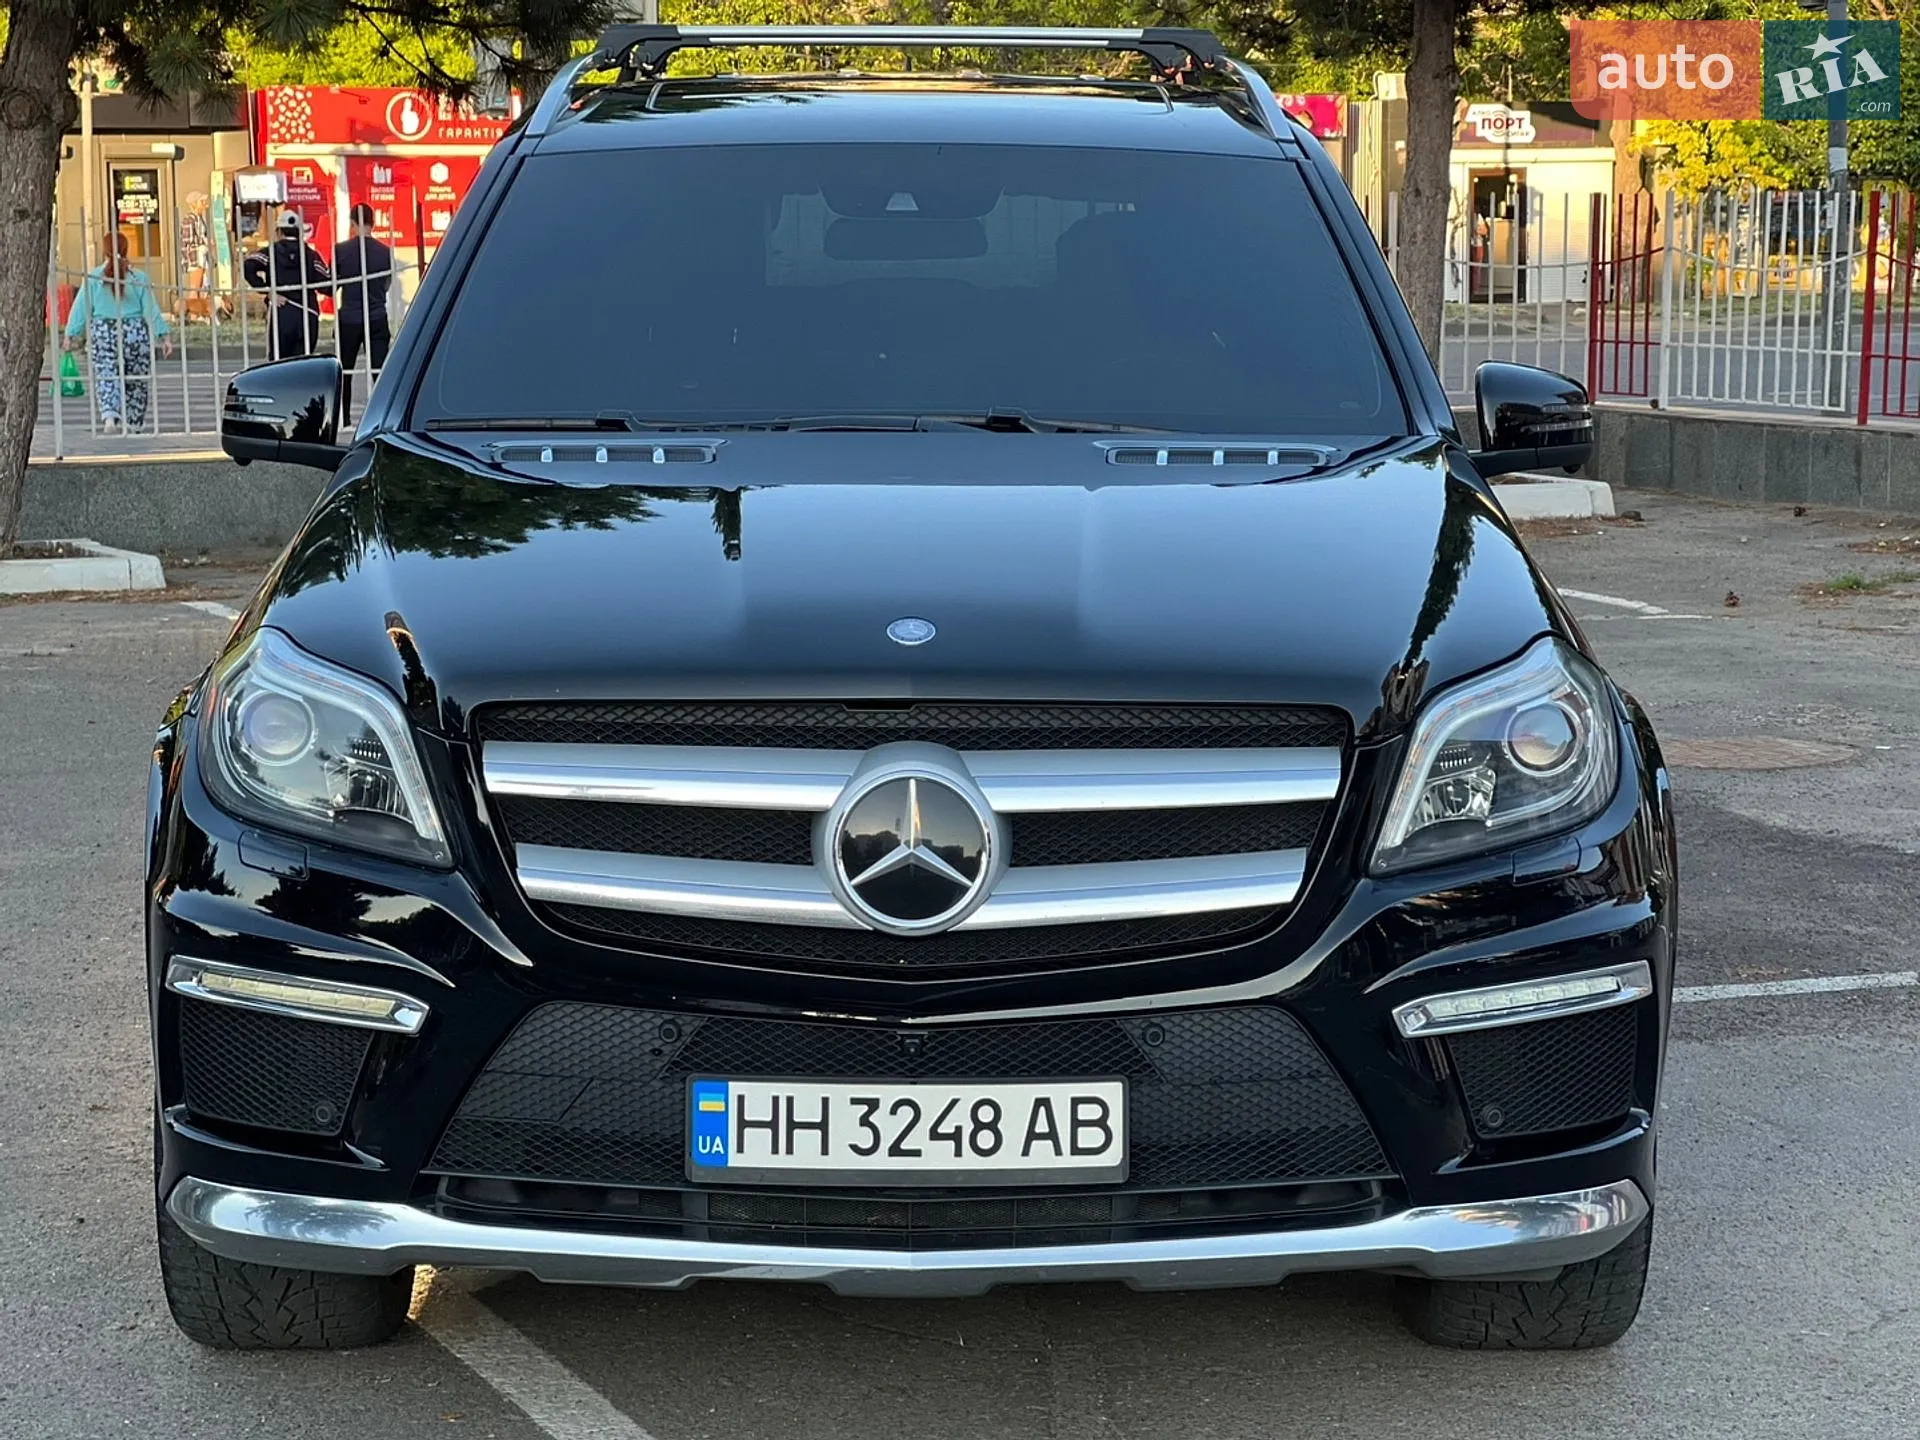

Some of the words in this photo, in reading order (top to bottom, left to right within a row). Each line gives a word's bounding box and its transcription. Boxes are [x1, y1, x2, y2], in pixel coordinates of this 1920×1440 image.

[1481, 117, 1526, 130] ПОРТ
[438, 127, 504, 139] ГАРАНТІЯ
[736, 1094, 829, 1156] HH
[848, 1096, 1004, 1159] 3248
[1020, 1096, 1114, 1158] AB
[698, 1135, 725, 1155] UA
